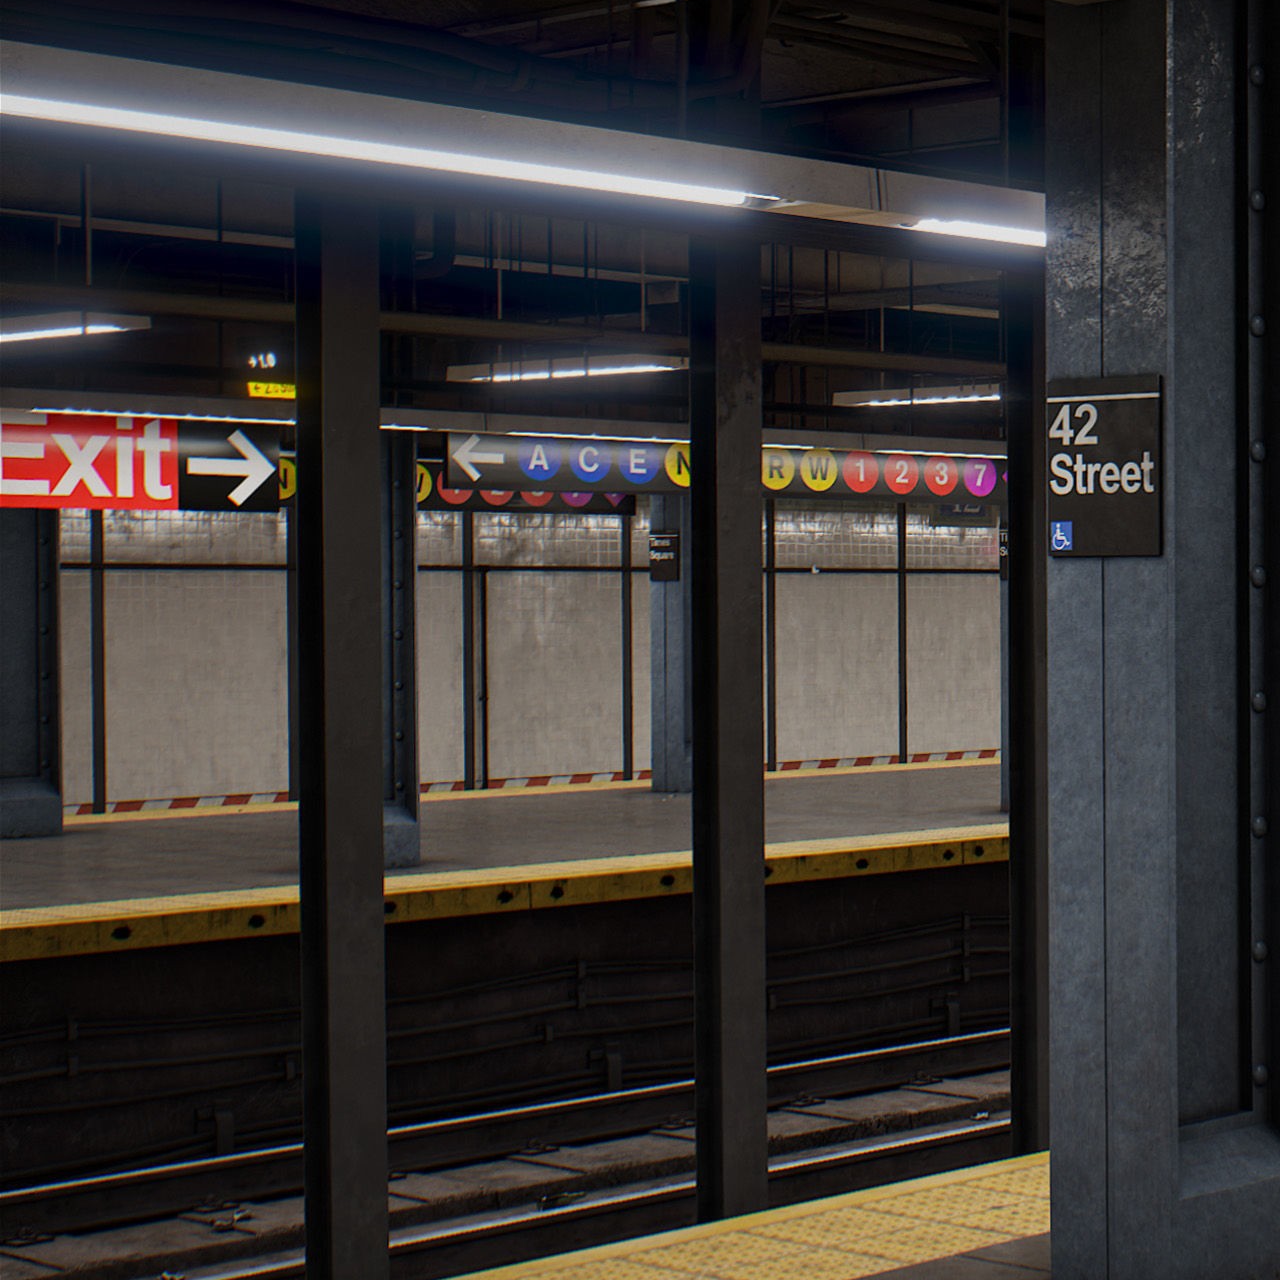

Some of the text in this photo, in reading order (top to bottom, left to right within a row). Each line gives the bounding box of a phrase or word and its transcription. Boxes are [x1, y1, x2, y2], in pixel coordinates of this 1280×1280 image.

[1048, 403, 1098, 446] 42
[0, 410, 172, 500] Exit
[528, 444, 549, 470] A
[577, 446, 599, 473] C
[629, 448, 647, 474] E
[807, 456, 830, 481] W
[1050, 451, 1155, 495] Street
